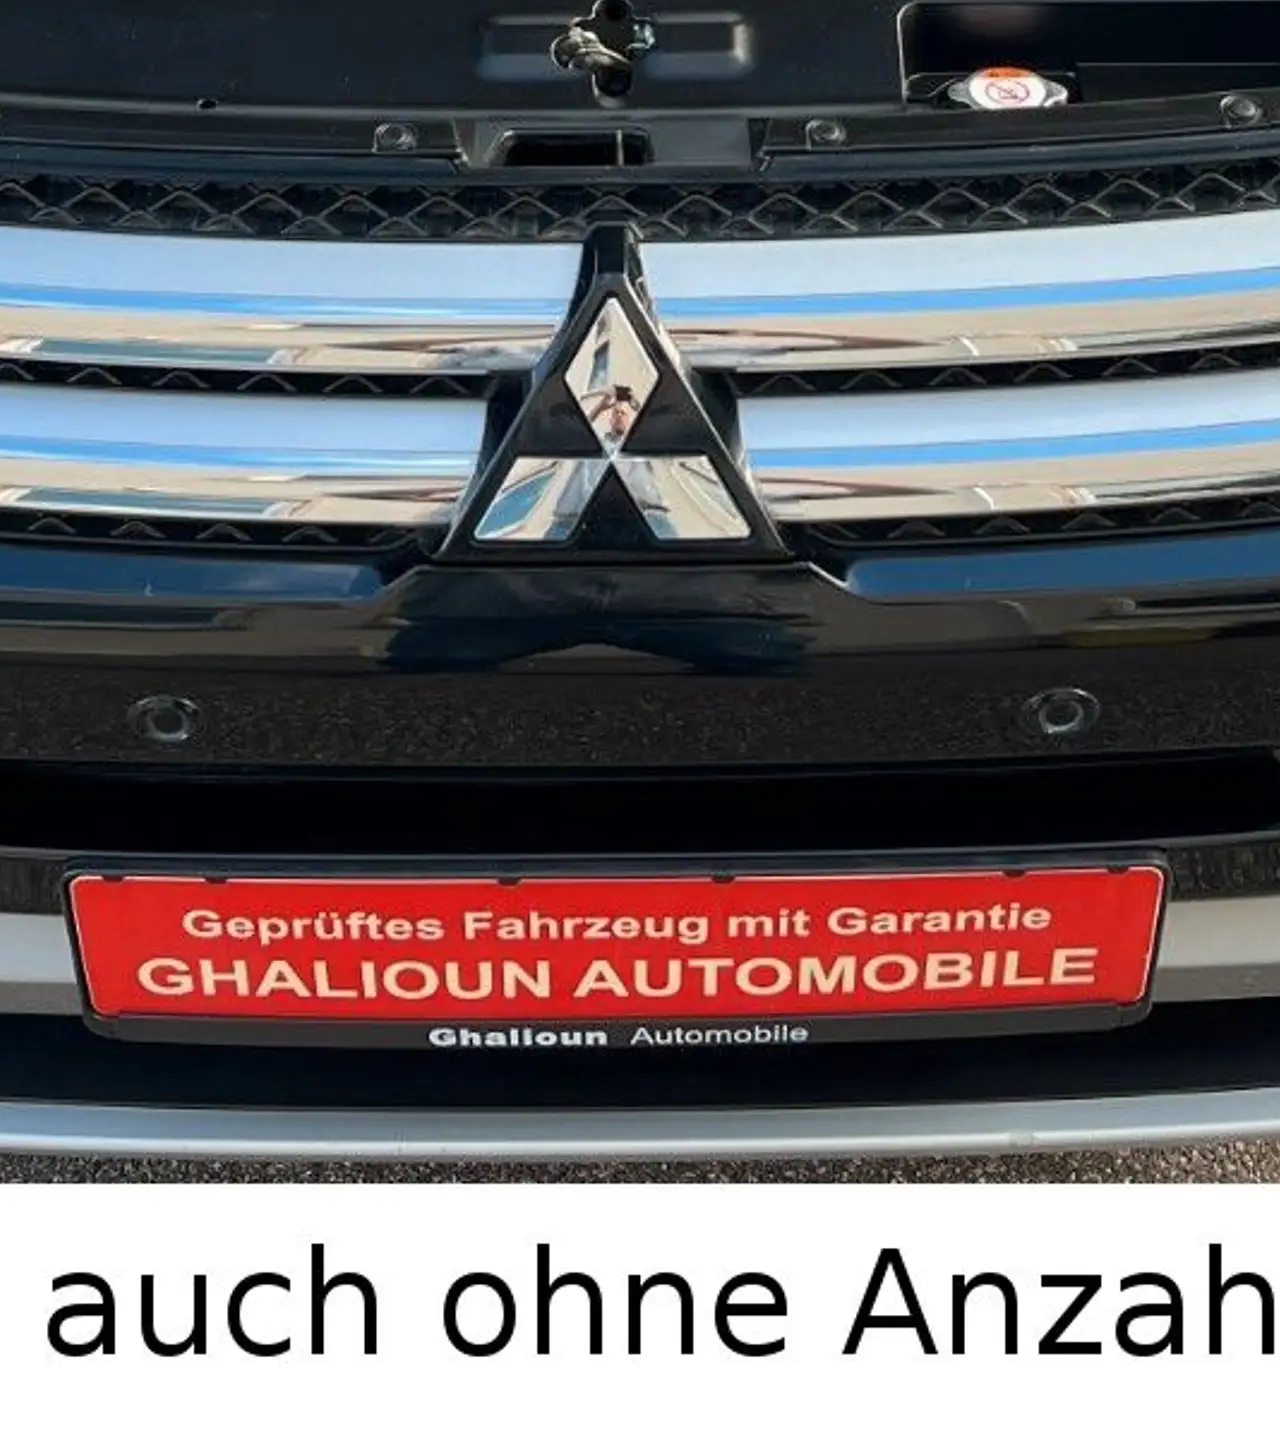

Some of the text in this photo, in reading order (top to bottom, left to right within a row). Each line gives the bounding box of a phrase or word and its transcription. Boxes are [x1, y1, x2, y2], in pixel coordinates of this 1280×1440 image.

[182, 903, 1053, 945] Geprüftes Fahrzeug mit Garantie
[137, 948, 1100, 1000] GHALIOUN AUTOMOBILE
[428, 1023, 810, 1048] Ghalioun Automobile
